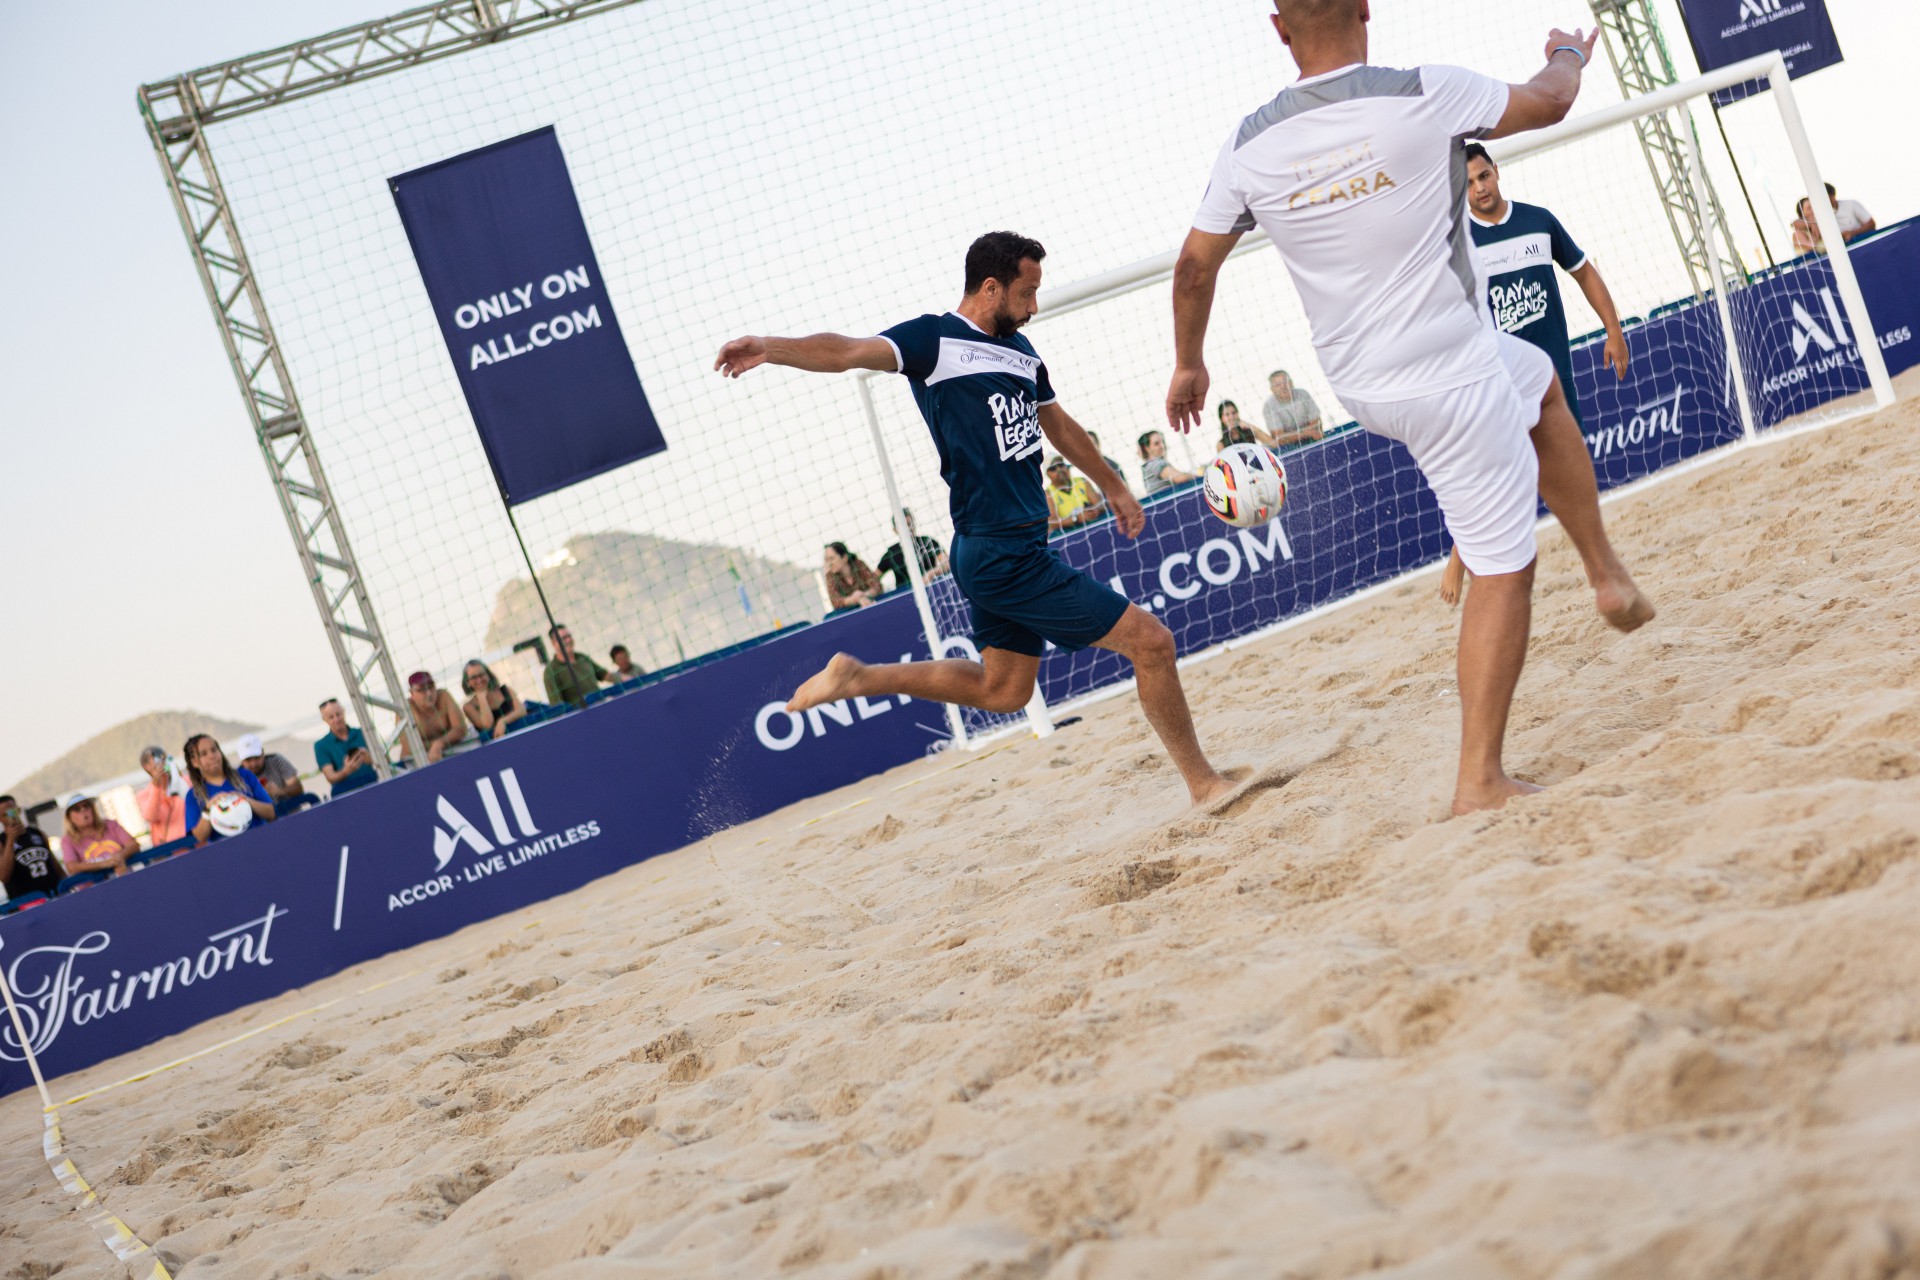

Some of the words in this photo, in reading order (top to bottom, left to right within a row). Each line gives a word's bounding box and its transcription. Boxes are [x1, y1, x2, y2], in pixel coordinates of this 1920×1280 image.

[1288, 171, 1397, 211] CEARA
[454, 283, 534, 330] ONLY
[541, 265, 591, 300] ON
[1490, 278, 1524, 309] PLAY
[1522, 281, 1541, 299] WITH
[1493, 290, 1548, 332] LEGENDS
[1791, 285, 1853, 364] Al
[470, 305, 602, 371] ALL.COM
[1762, 366, 1809, 395] ACCOR
[1815, 351, 1846, 374] LIVE
[1845, 325, 1912, 362] LILESS
[987, 390, 1024, 425] PLAY
[433, 767, 543, 873] All
[388, 874, 454, 912] ACCOR
[463, 855, 508, 883] LIVE
[508, 820, 602, 867] LIMITLESS
[0, 903, 289, 1062] Fairmont
